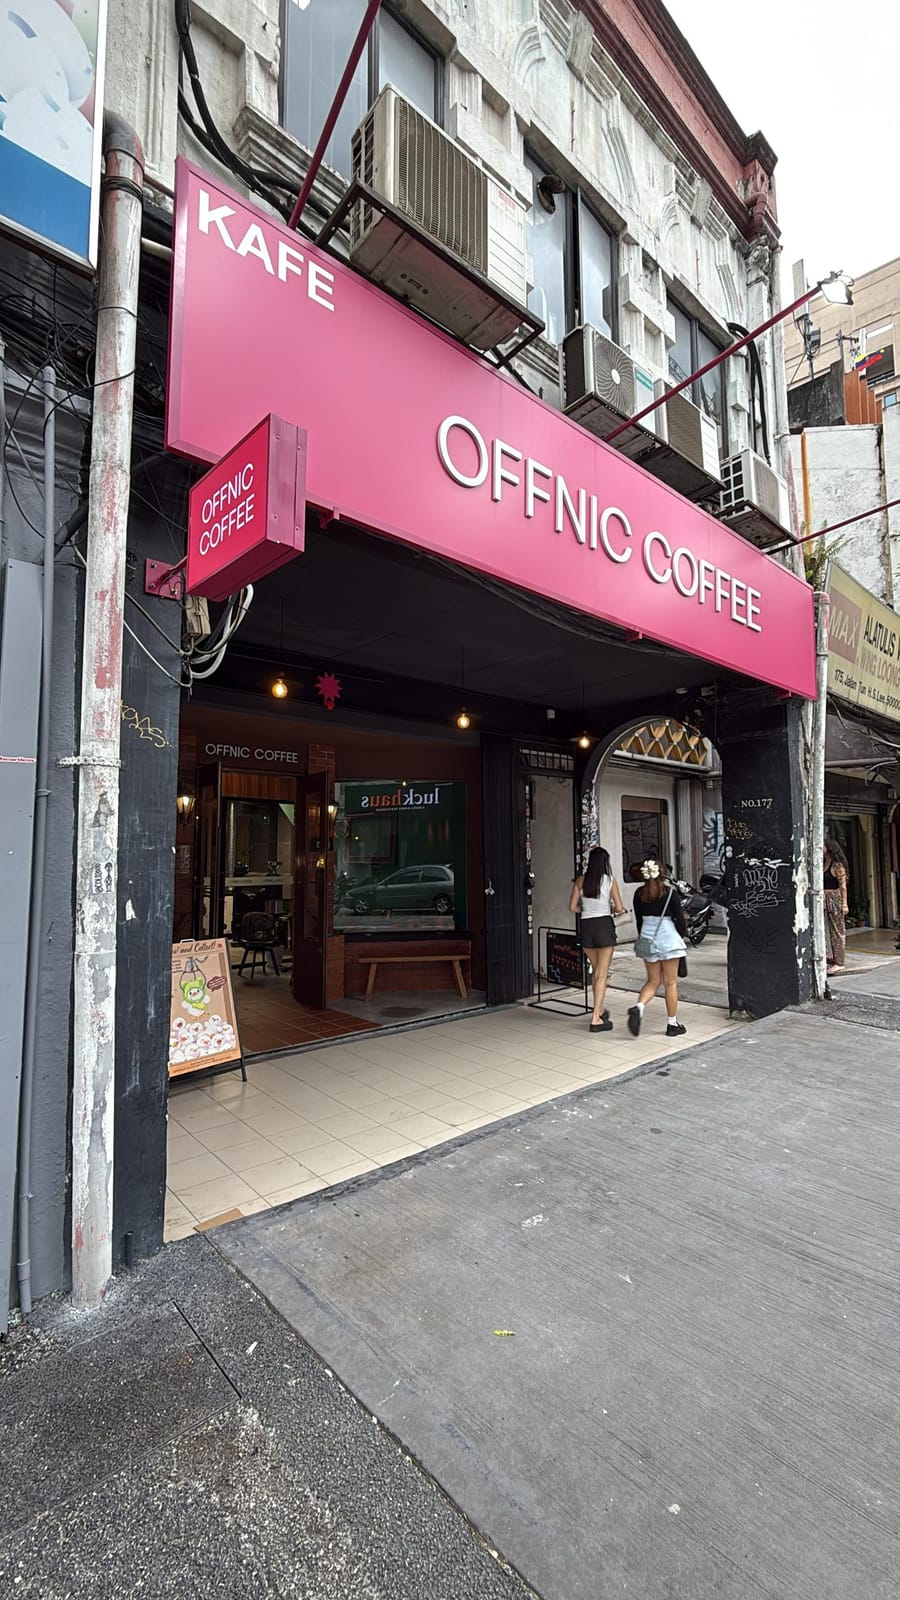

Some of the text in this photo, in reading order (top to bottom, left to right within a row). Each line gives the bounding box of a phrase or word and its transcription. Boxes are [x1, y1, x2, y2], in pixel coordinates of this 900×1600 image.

[198, 189, 335, 312] KAFE
[201, 463, 254, 524] OFFNIC
[199, 493, 255, 556] COFFEE
[437, 415, 762, 633] OFFNIC COFFEE
[863, 614, 897, 658] ALATULIS
[860, 646, 878, 677] WING
[858, 681, 867, 695] Tun
[205, 743, 299, 764] OFFNIC COFFEE
[741, 798, 773, 808] NO.177
